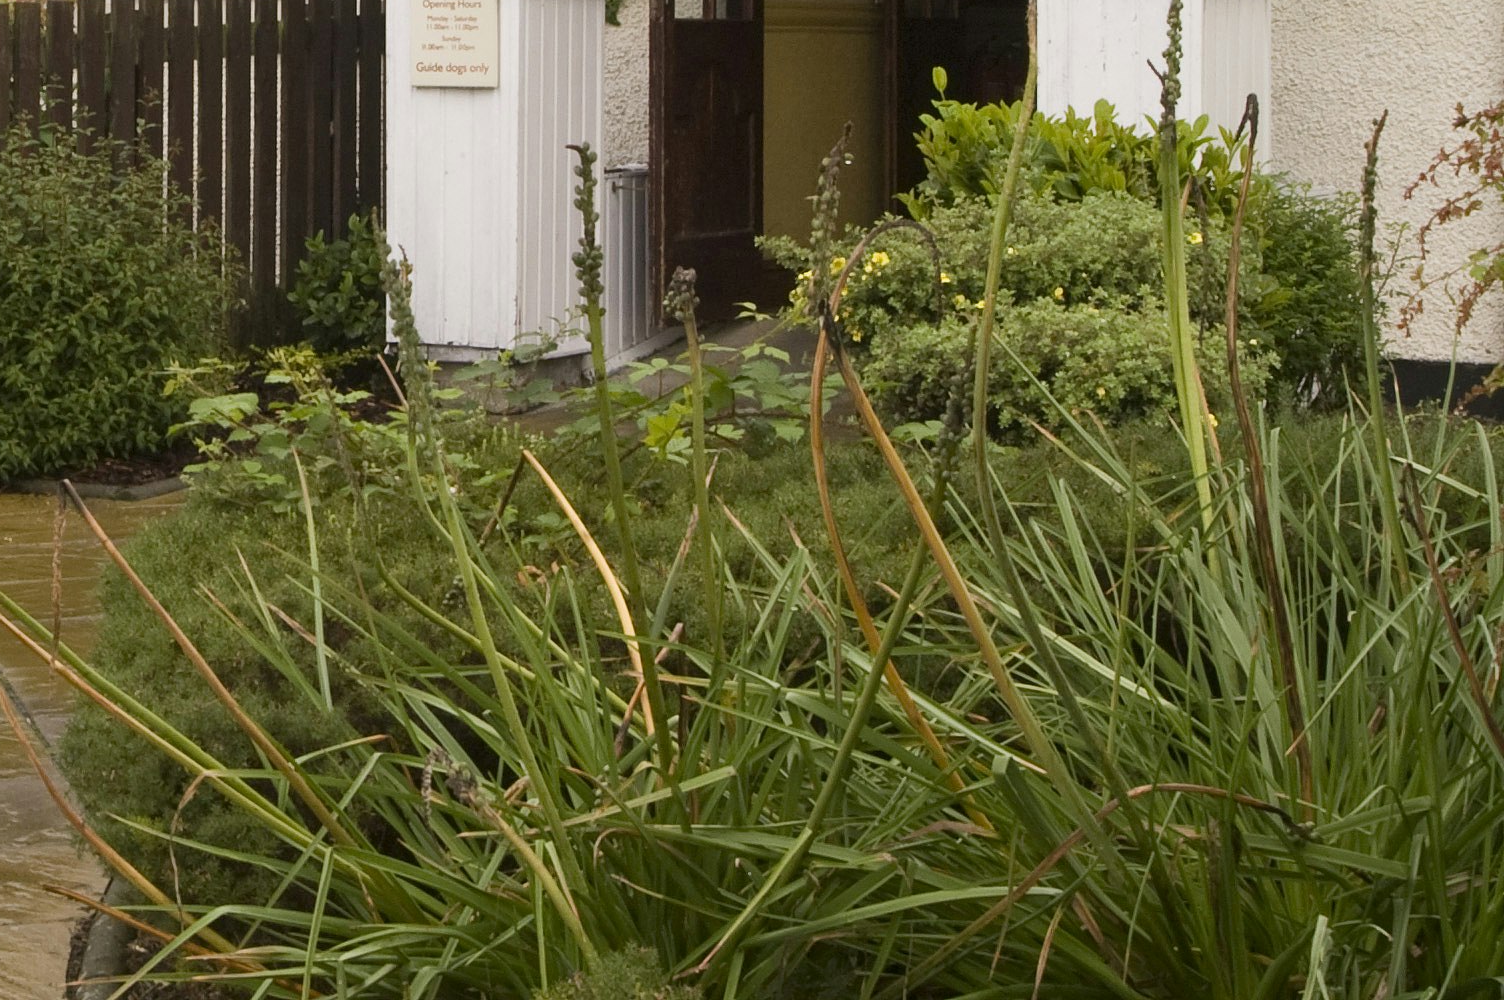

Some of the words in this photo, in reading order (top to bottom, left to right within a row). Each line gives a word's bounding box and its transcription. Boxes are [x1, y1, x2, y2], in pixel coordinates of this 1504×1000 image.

[422, 0, 456, 10] Opening
[457, 0, 482, 8] Hours
[416, 62, 443, 73] Guide
[446, 63, 467, 75] dogs
[469, 63, 490, 75] only
